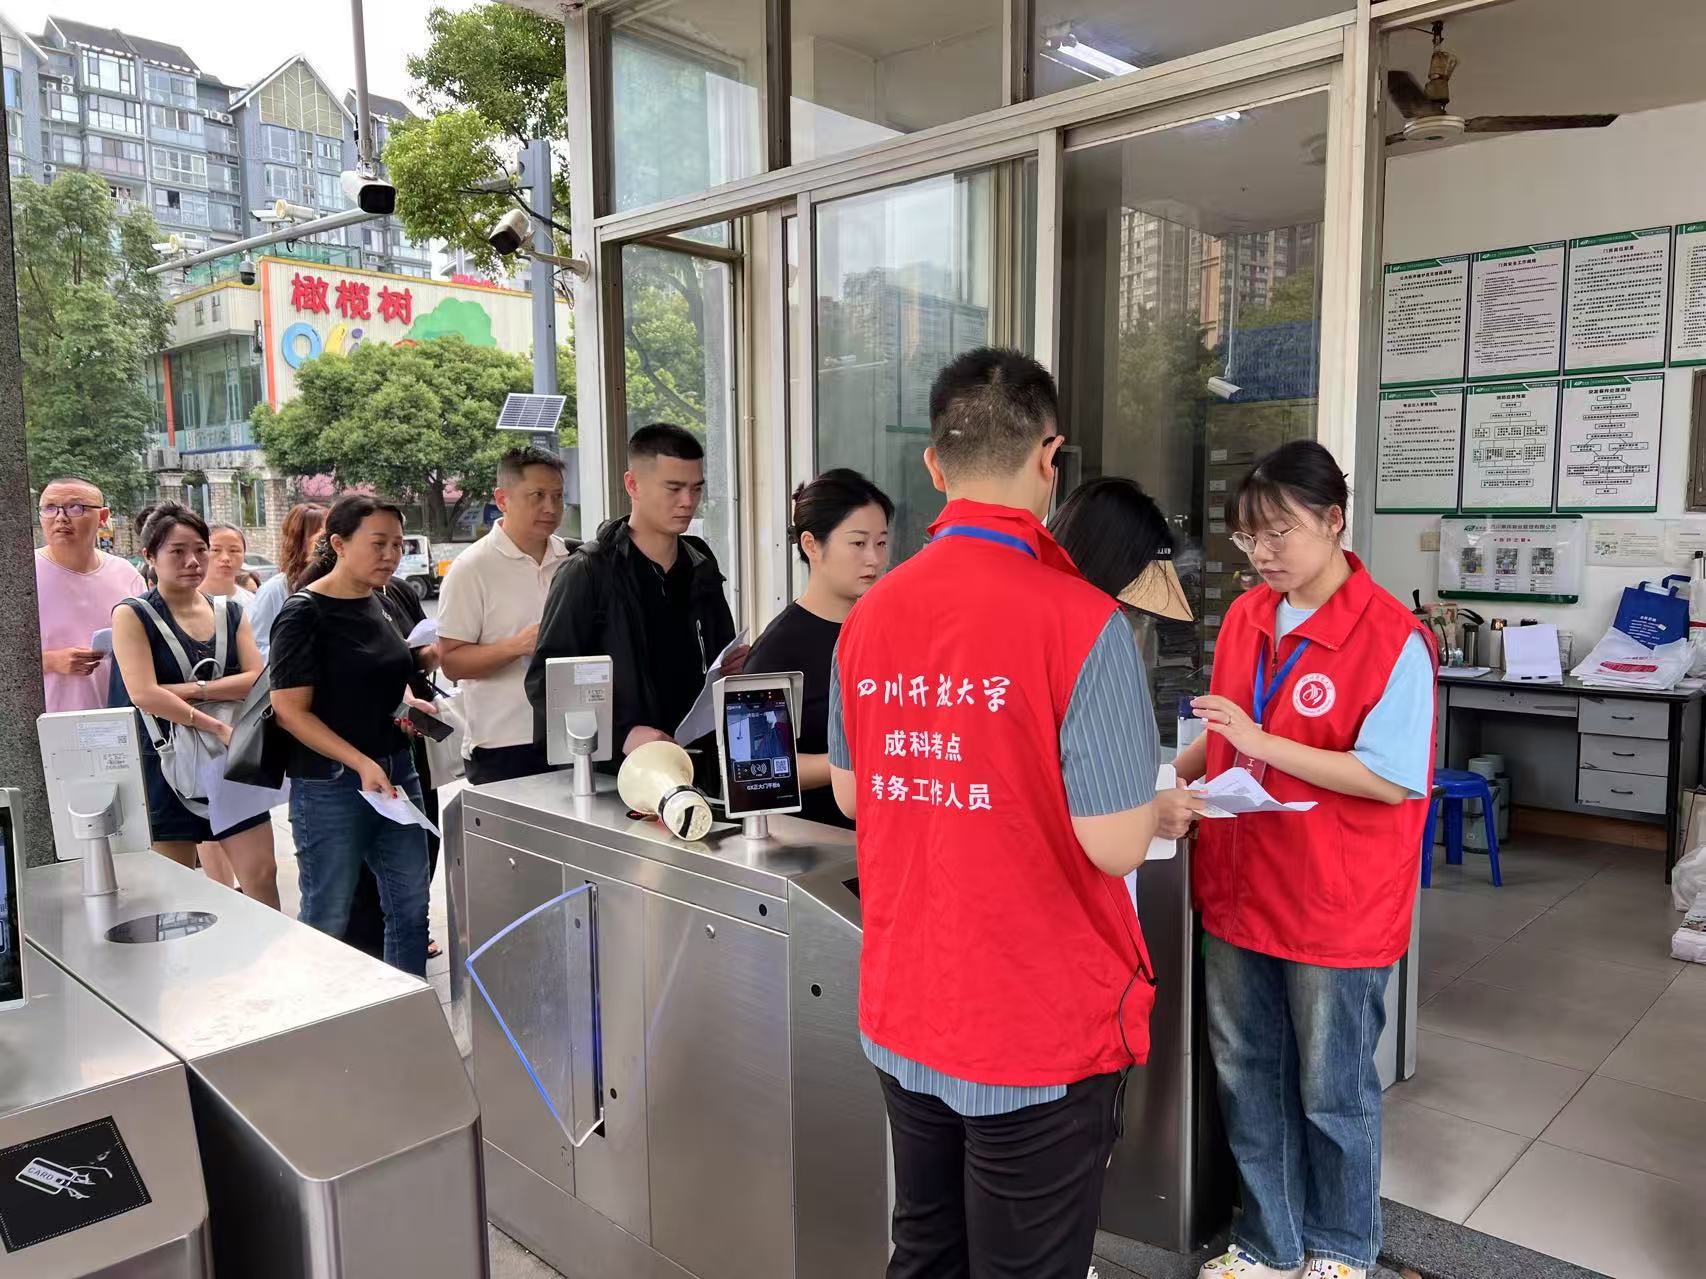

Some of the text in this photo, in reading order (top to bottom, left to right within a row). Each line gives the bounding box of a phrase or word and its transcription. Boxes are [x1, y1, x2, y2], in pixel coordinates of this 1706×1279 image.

[291, 272, 413, 326] 橄榄树
[857, 673, 1011, 712] 四川开放大学
[884, 729, 962, 762] 成科考点
[871, 773, 993, 811] 考务工作人员
[28, 1166, 55, 1181] CARD
